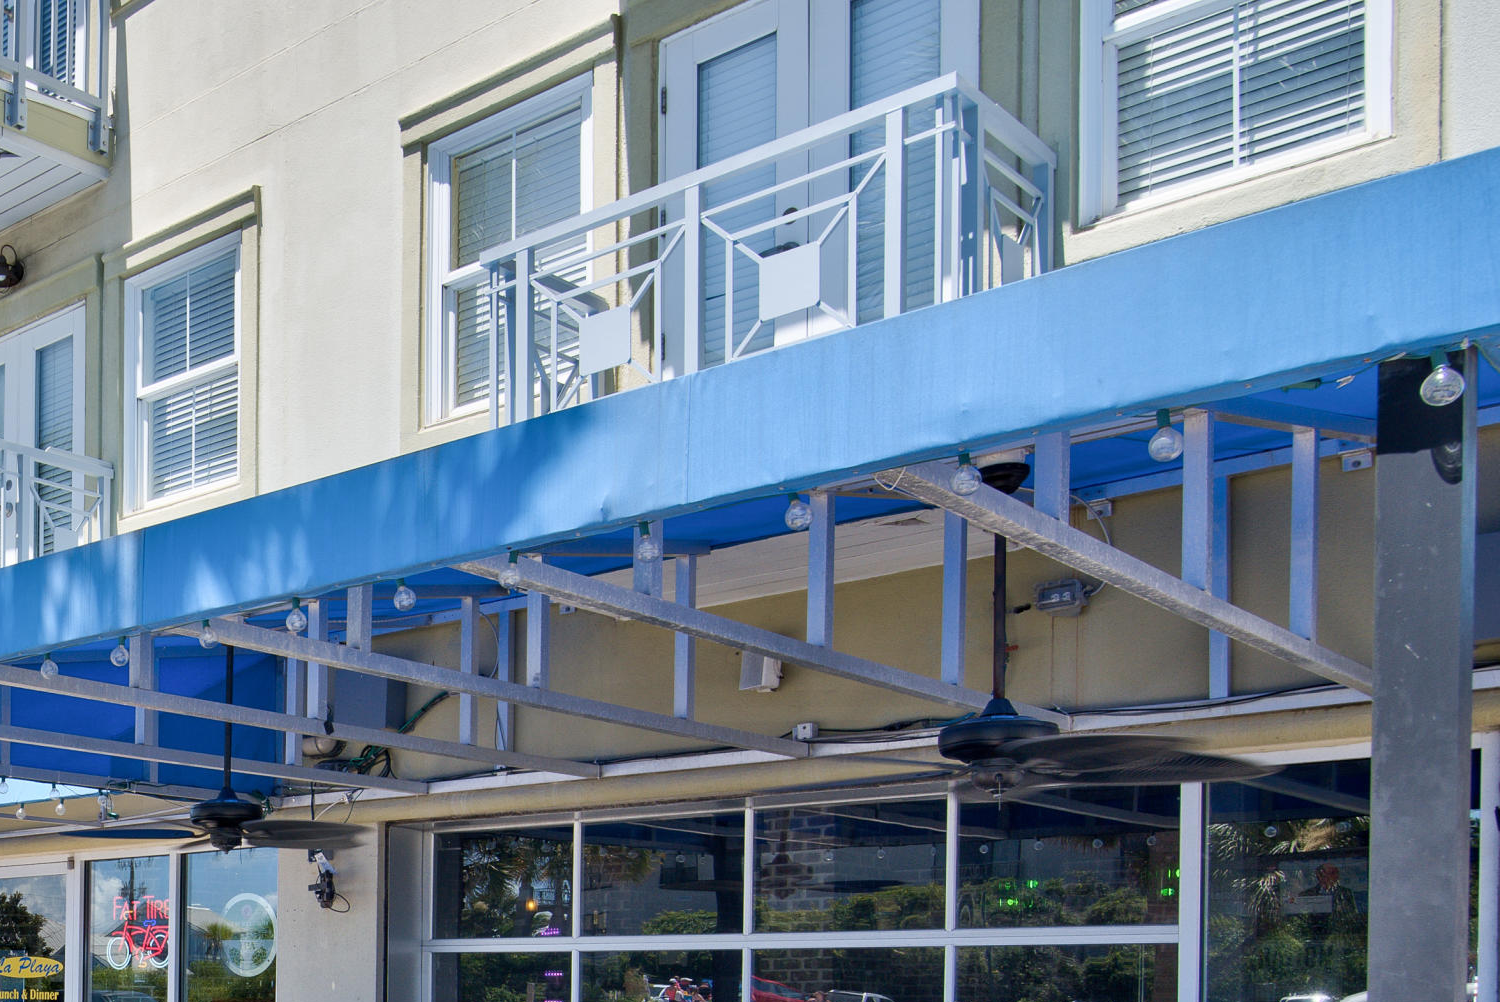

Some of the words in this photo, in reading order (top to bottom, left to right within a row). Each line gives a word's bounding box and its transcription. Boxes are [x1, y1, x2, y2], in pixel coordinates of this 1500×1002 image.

[113, 896, 140, 920] FAT
[142, 895, 169, 919] TIRE
[18, 957, 60, 977] Playa
[21, 989, 28, 1000] &
[29, 989, 59, 1000] Dinner
